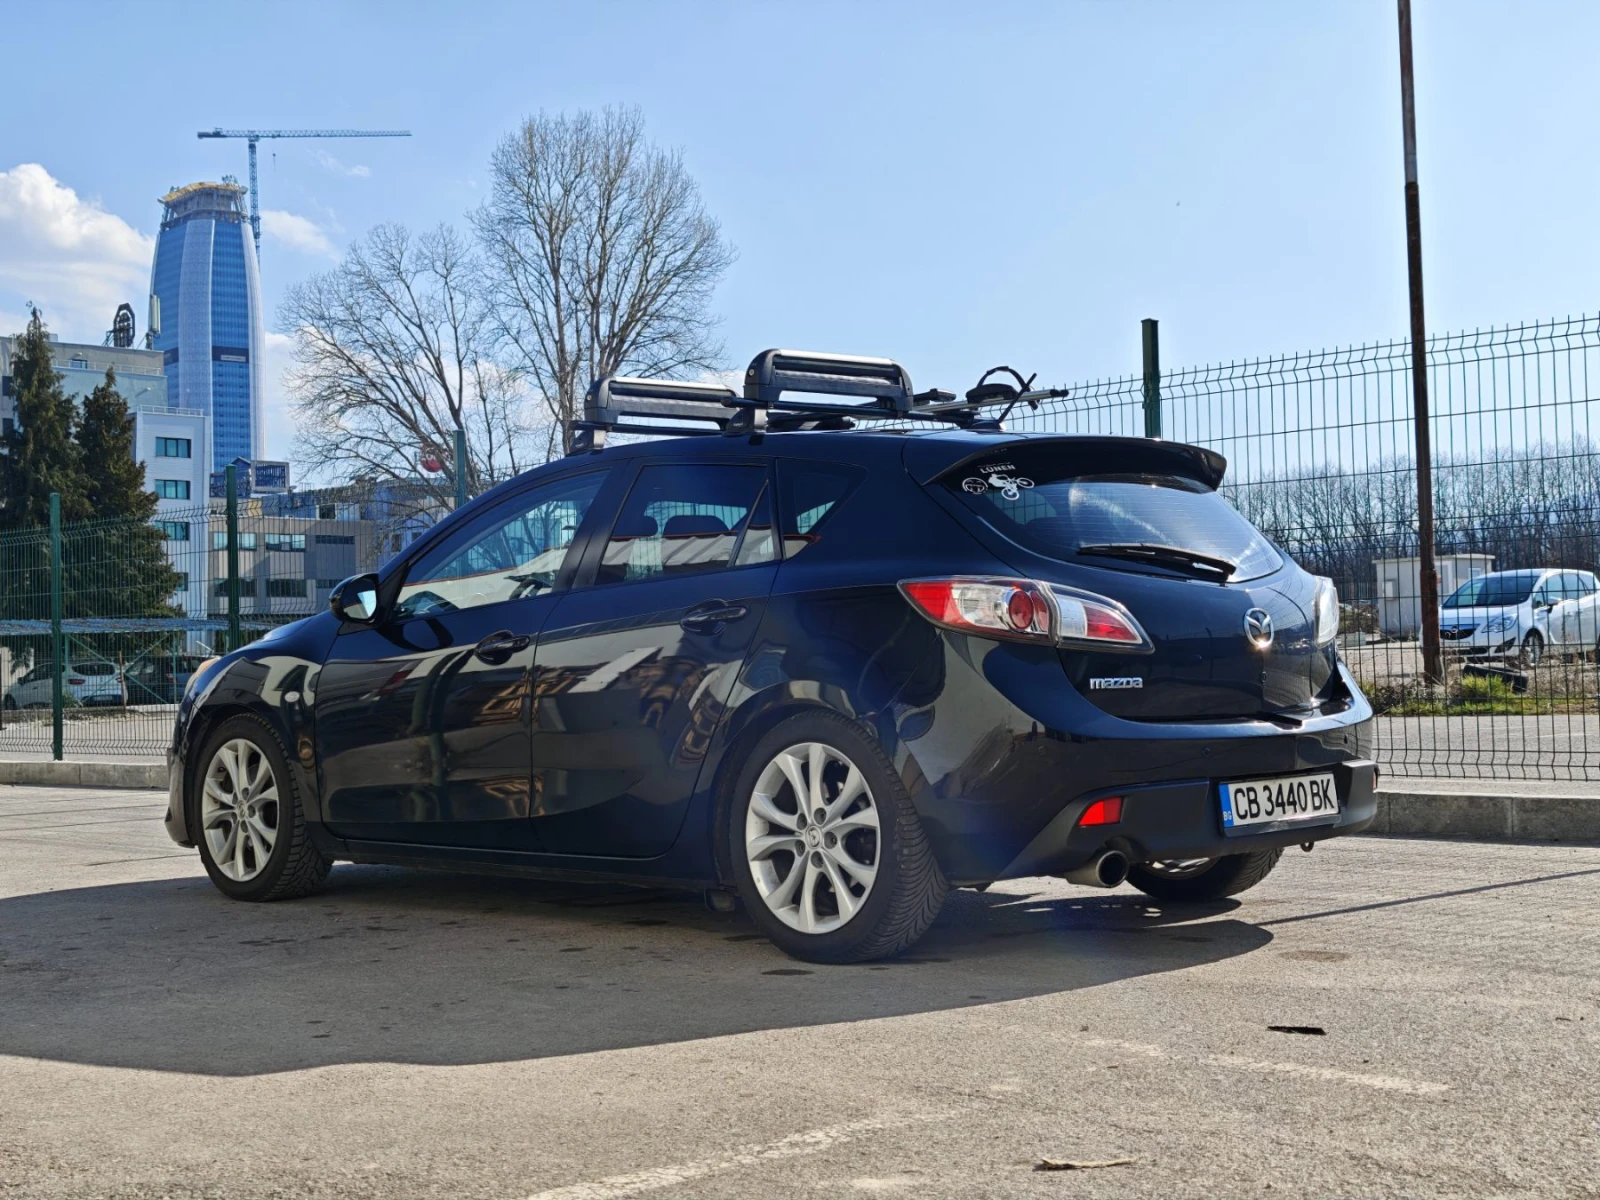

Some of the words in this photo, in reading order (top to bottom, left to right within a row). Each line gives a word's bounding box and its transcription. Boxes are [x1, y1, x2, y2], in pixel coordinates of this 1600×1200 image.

[1089, 677, 1143, 689] mazda
[1234, 786, 1260, 820] CB
[1262, 782, 1308, 816] 3440
[1309, 779, 1335, 810] BK
[1223, 811, 1232, 821] BG
